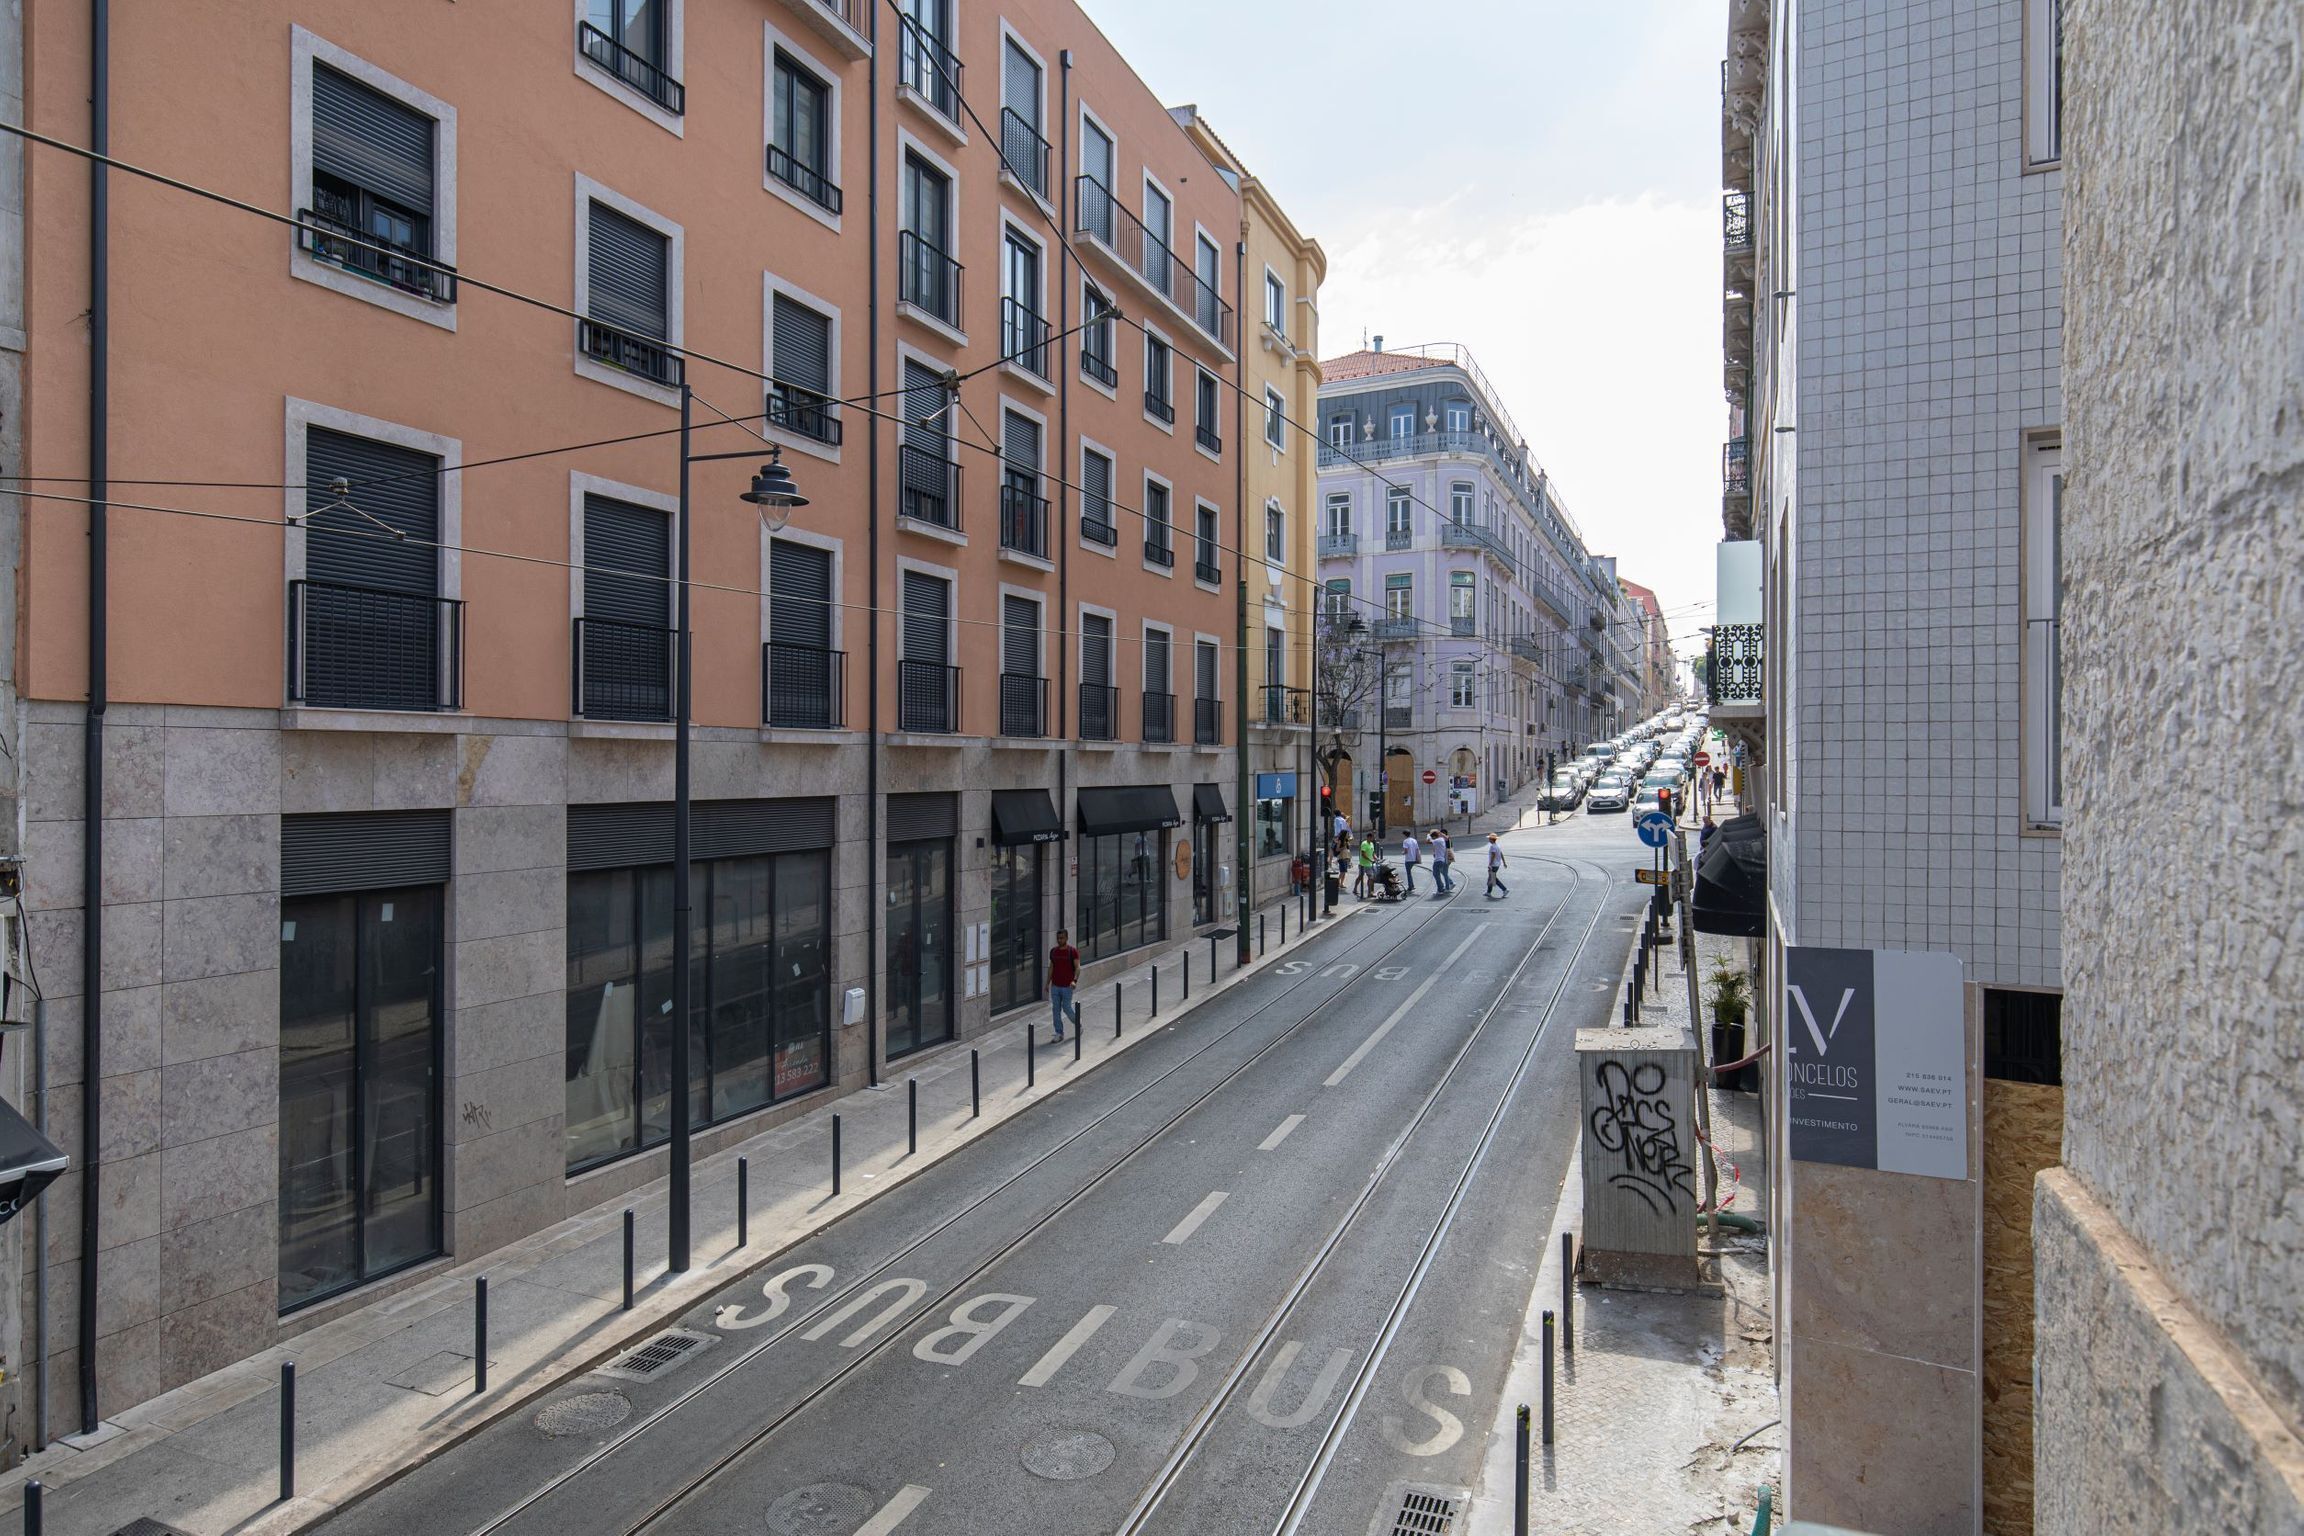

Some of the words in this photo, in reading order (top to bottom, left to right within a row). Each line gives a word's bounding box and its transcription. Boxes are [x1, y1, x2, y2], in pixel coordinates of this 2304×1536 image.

[1275, 961, 1412, 981] BUS
[1787, 984, 1855, 1057] V
[1887, 1097, 1952, 1109] GERAL@SAEV.PT
[1897, 1085, 1952, 1095] WWW.SAEV.PT
[715, 1263, 1038, 1366] BUS
[1105, 1317, 1472, 1457] BUS
